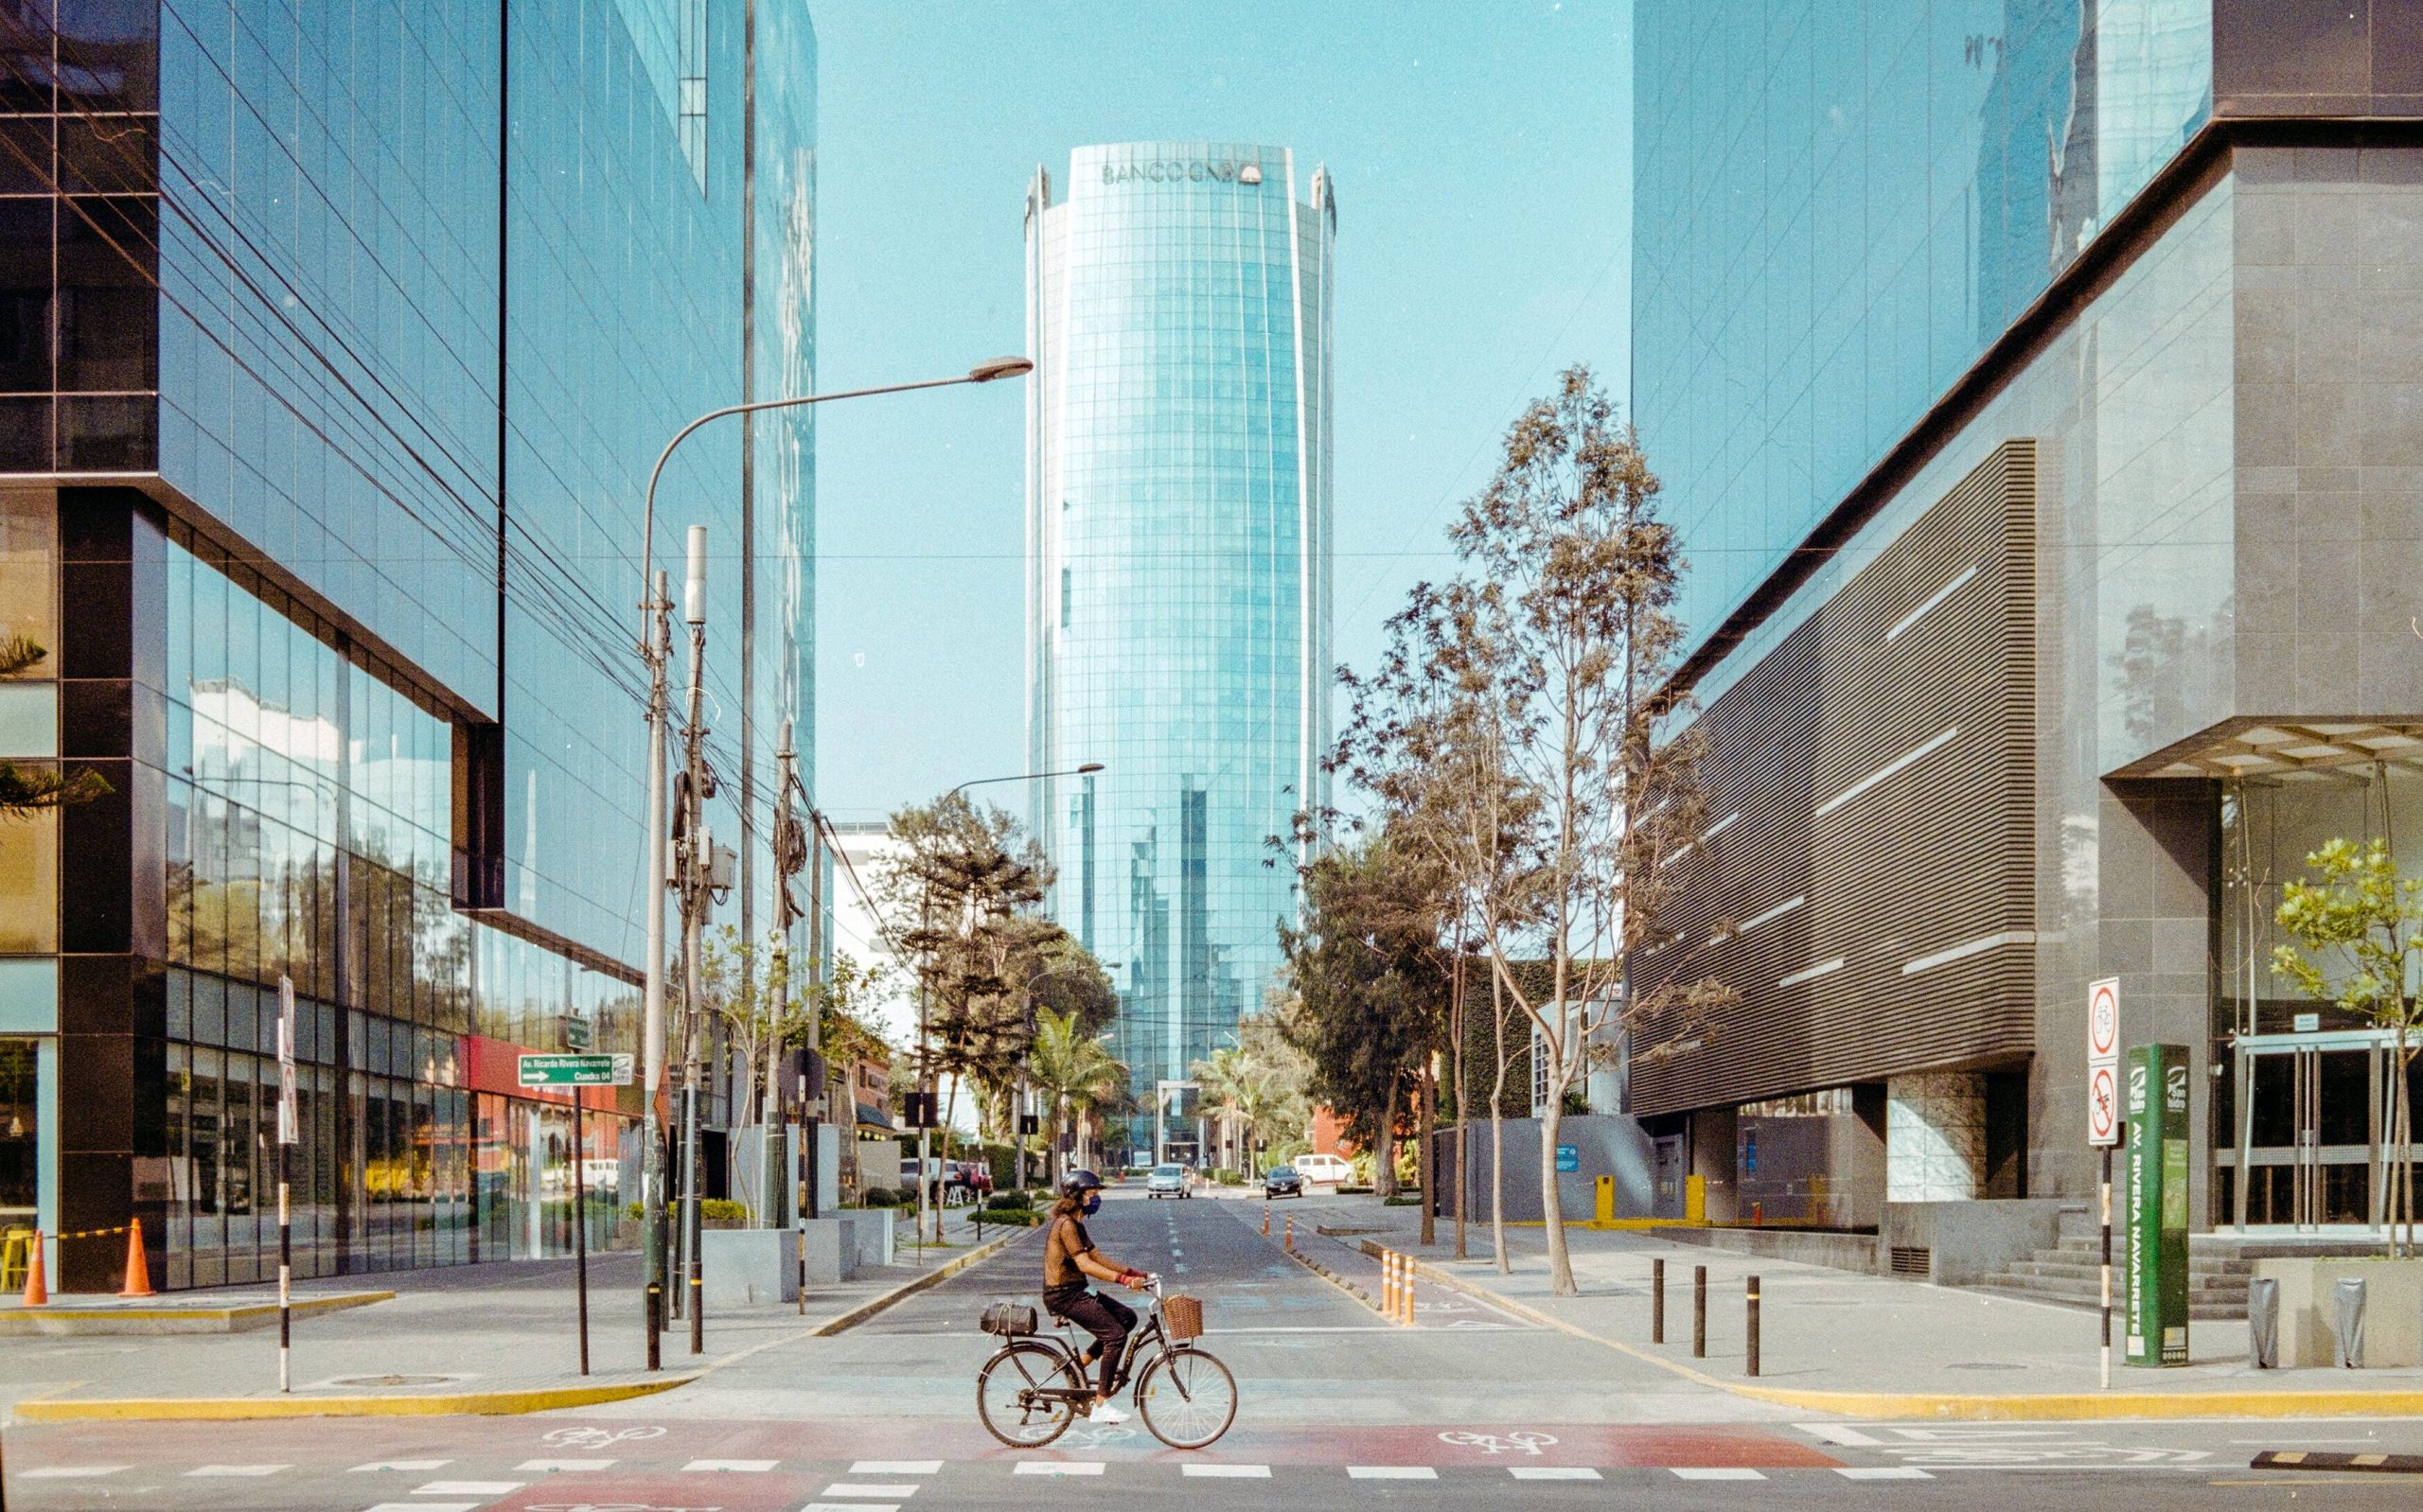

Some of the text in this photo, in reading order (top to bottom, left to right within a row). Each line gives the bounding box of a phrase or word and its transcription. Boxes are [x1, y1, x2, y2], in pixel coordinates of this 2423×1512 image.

[1102, 162, 1183, 185] BANCO
[522, 1059, 610, 1068] Av. Ricardo Rivera Navarrete
[574, 1071, 600, 1081] Cuadra
[601, 1071, 610, 1081] 04
[2131, 1121, 2142, 1150] AV.
[2131, 1153, 2142, 1222] RIVERA
[2131, 1225, 2141, 1336] NAVARRETE
